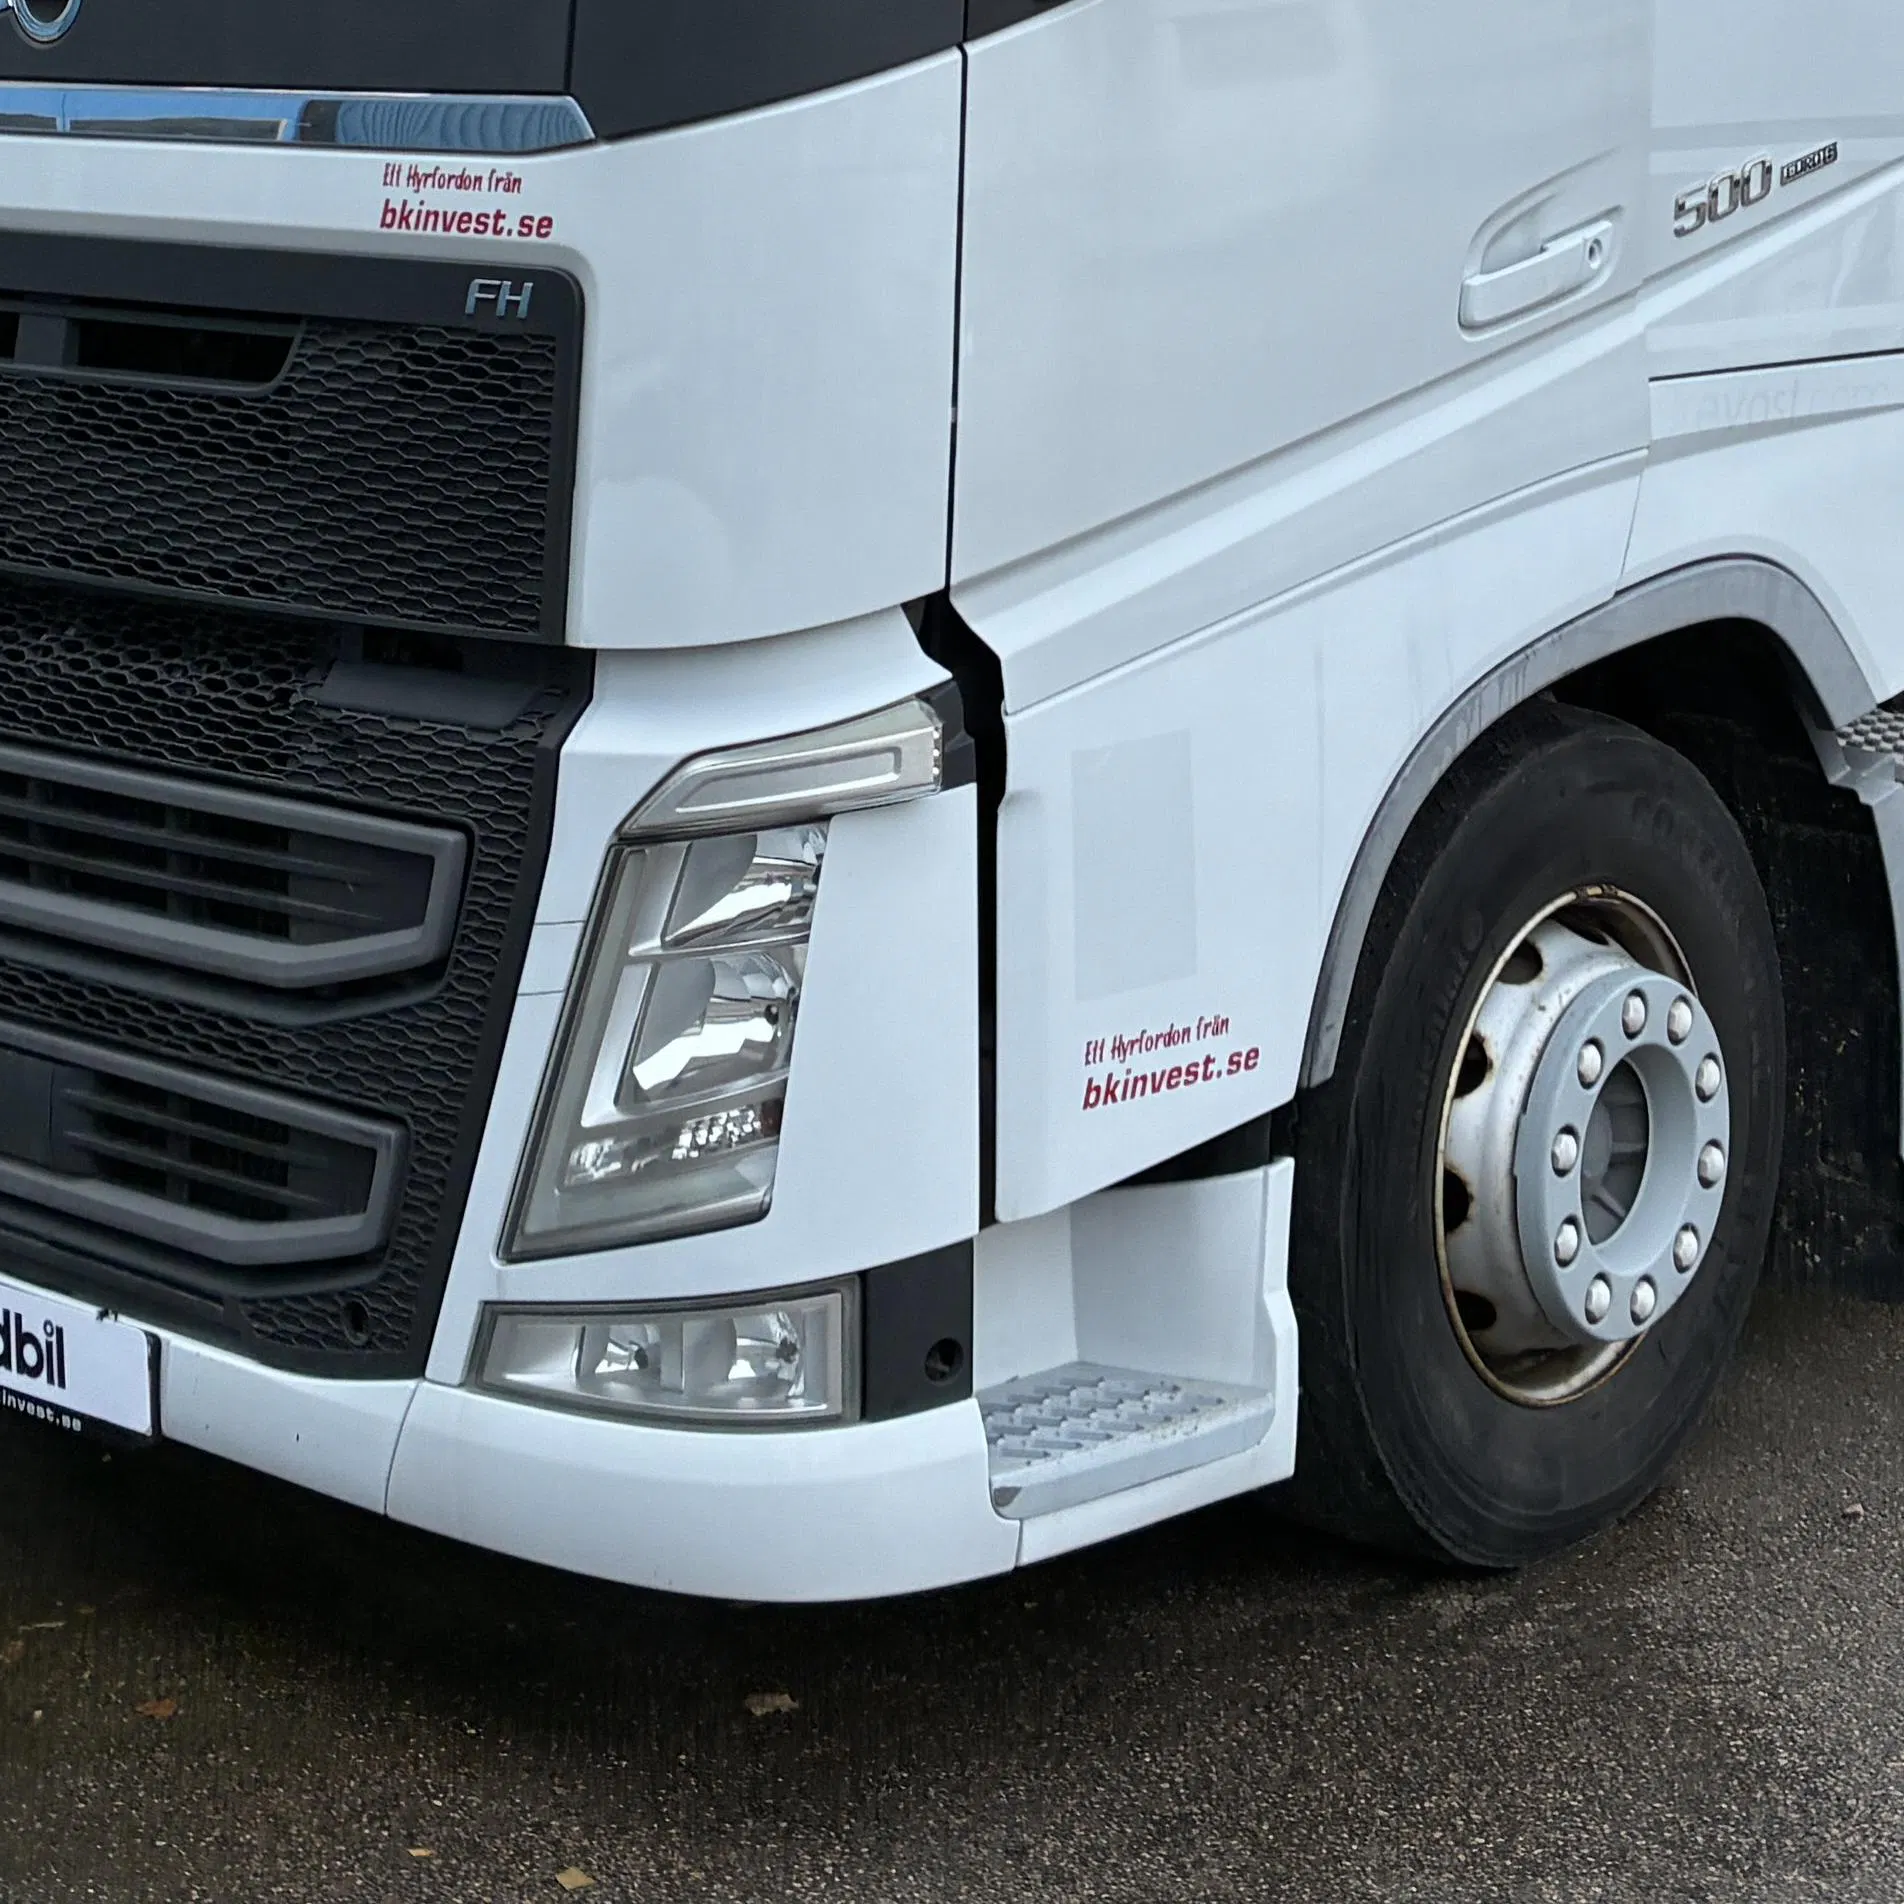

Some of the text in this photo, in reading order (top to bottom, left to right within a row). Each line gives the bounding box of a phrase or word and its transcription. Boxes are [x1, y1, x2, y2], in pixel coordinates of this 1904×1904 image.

[380, 198, 554, 239] bkinvest.se
[1673, 156, 1773, 238] 500
[464, 278, 534, 319] FH
[1082, 1046, 1260, 1110] bkinvest.se
